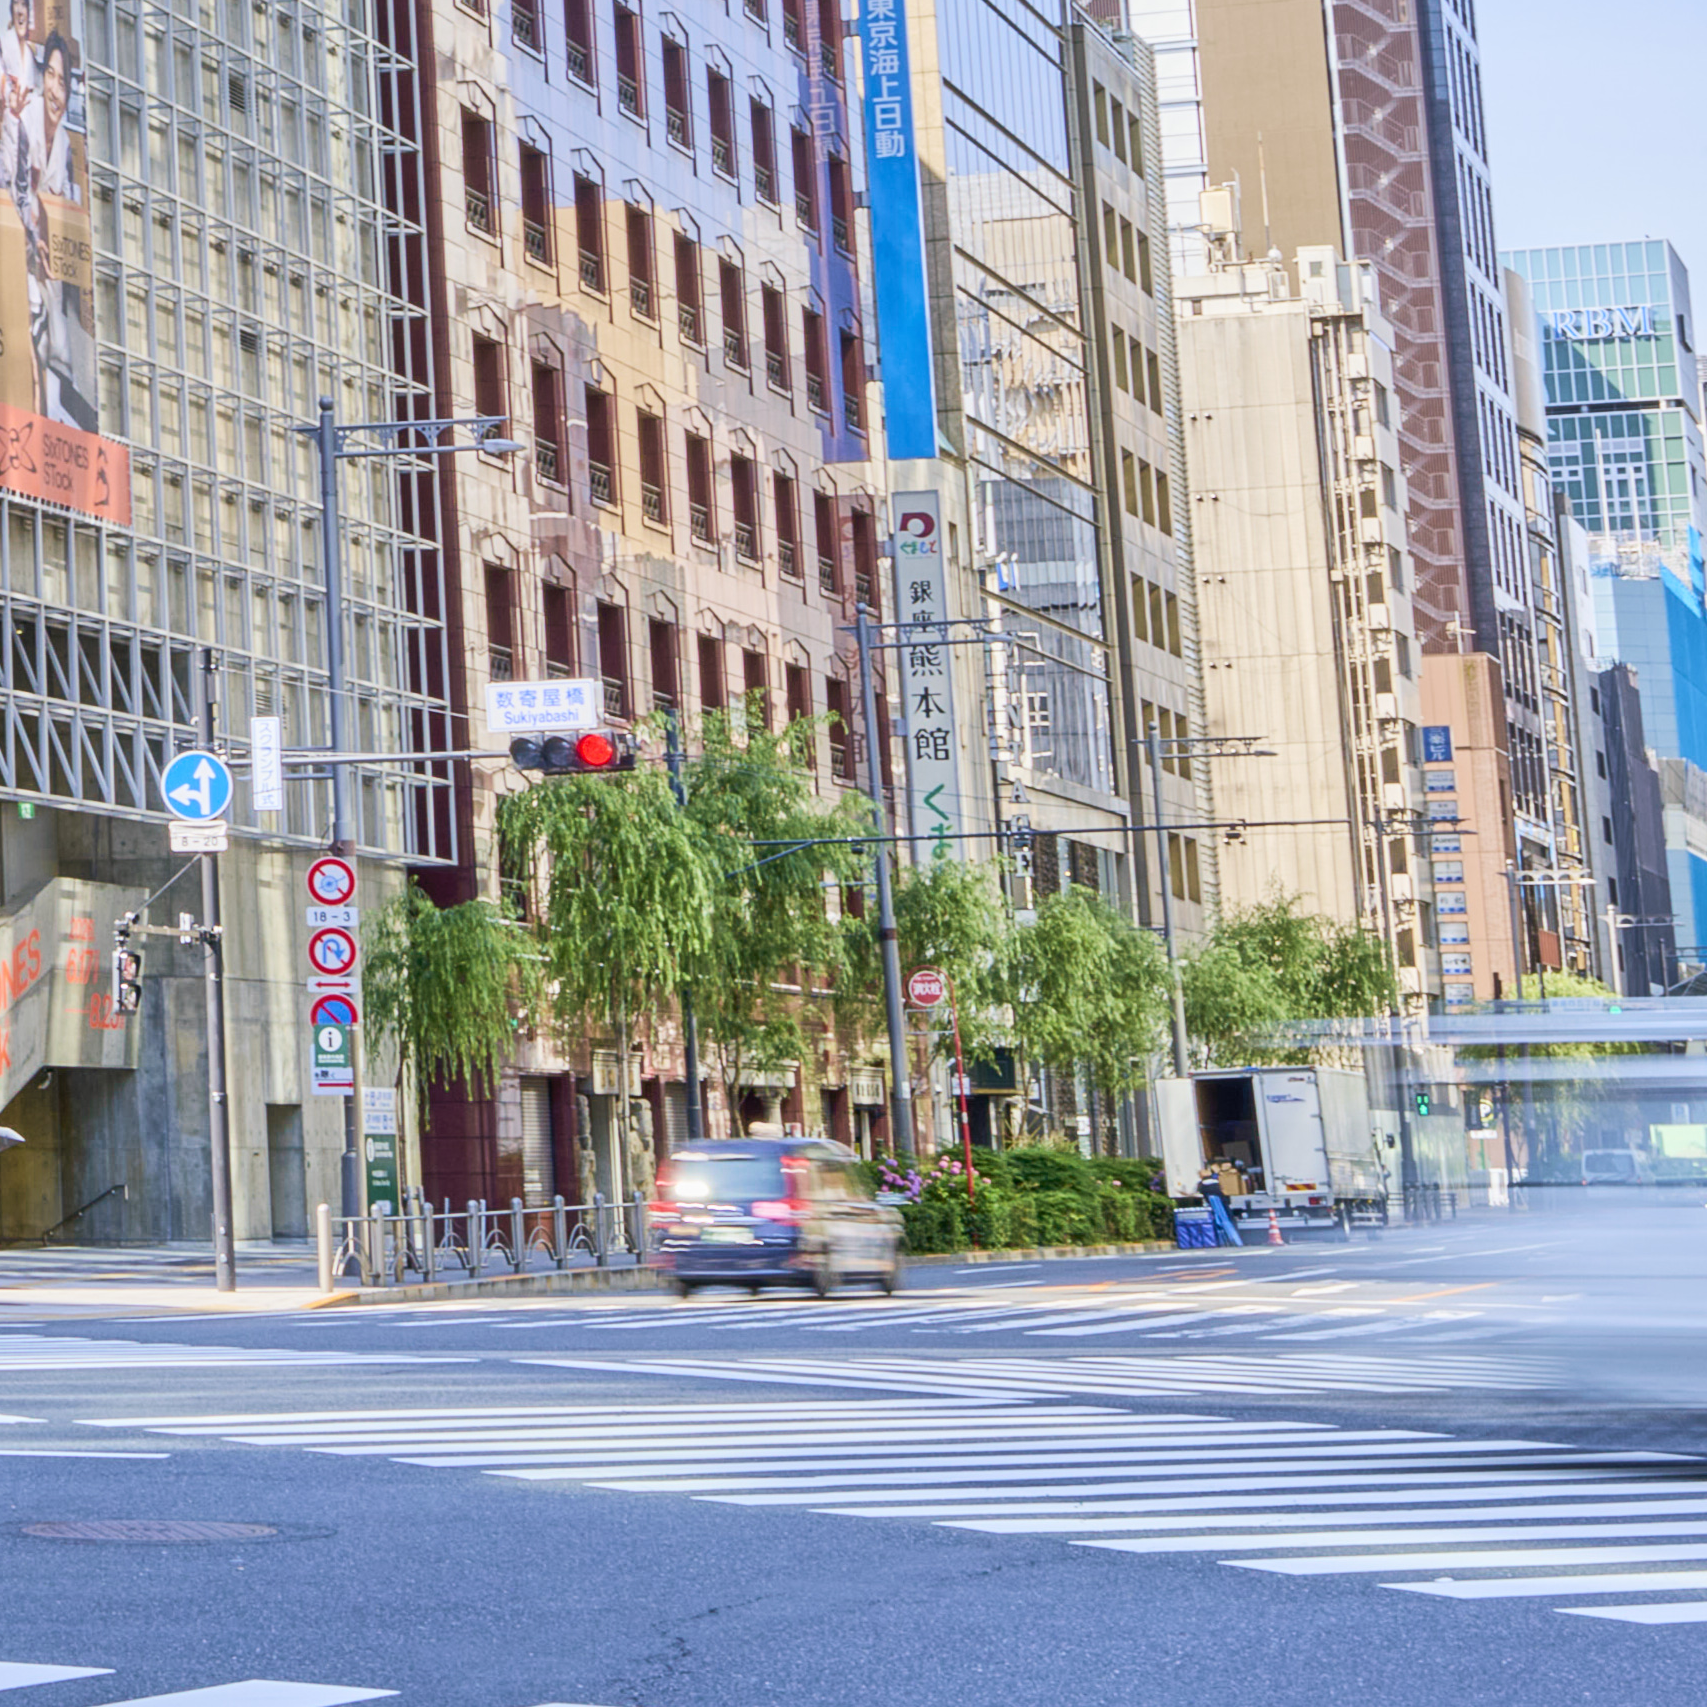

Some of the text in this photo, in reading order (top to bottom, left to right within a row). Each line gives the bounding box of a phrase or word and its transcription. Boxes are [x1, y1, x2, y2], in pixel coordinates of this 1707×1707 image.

[52, 233, 91, 264] SixTONES
[52, 254, 78, 279] STock
[1552, 305, 1655, 340] RBM
[42, 433, 88, 471] SixTONES
[43, 461, 74, 493] STock
[909, 580, 951, 761] 銀座熊本館
[496, 687, 585, 709] 数寄屋橋
[504, 709, 579, 726] Sukiyabashi
